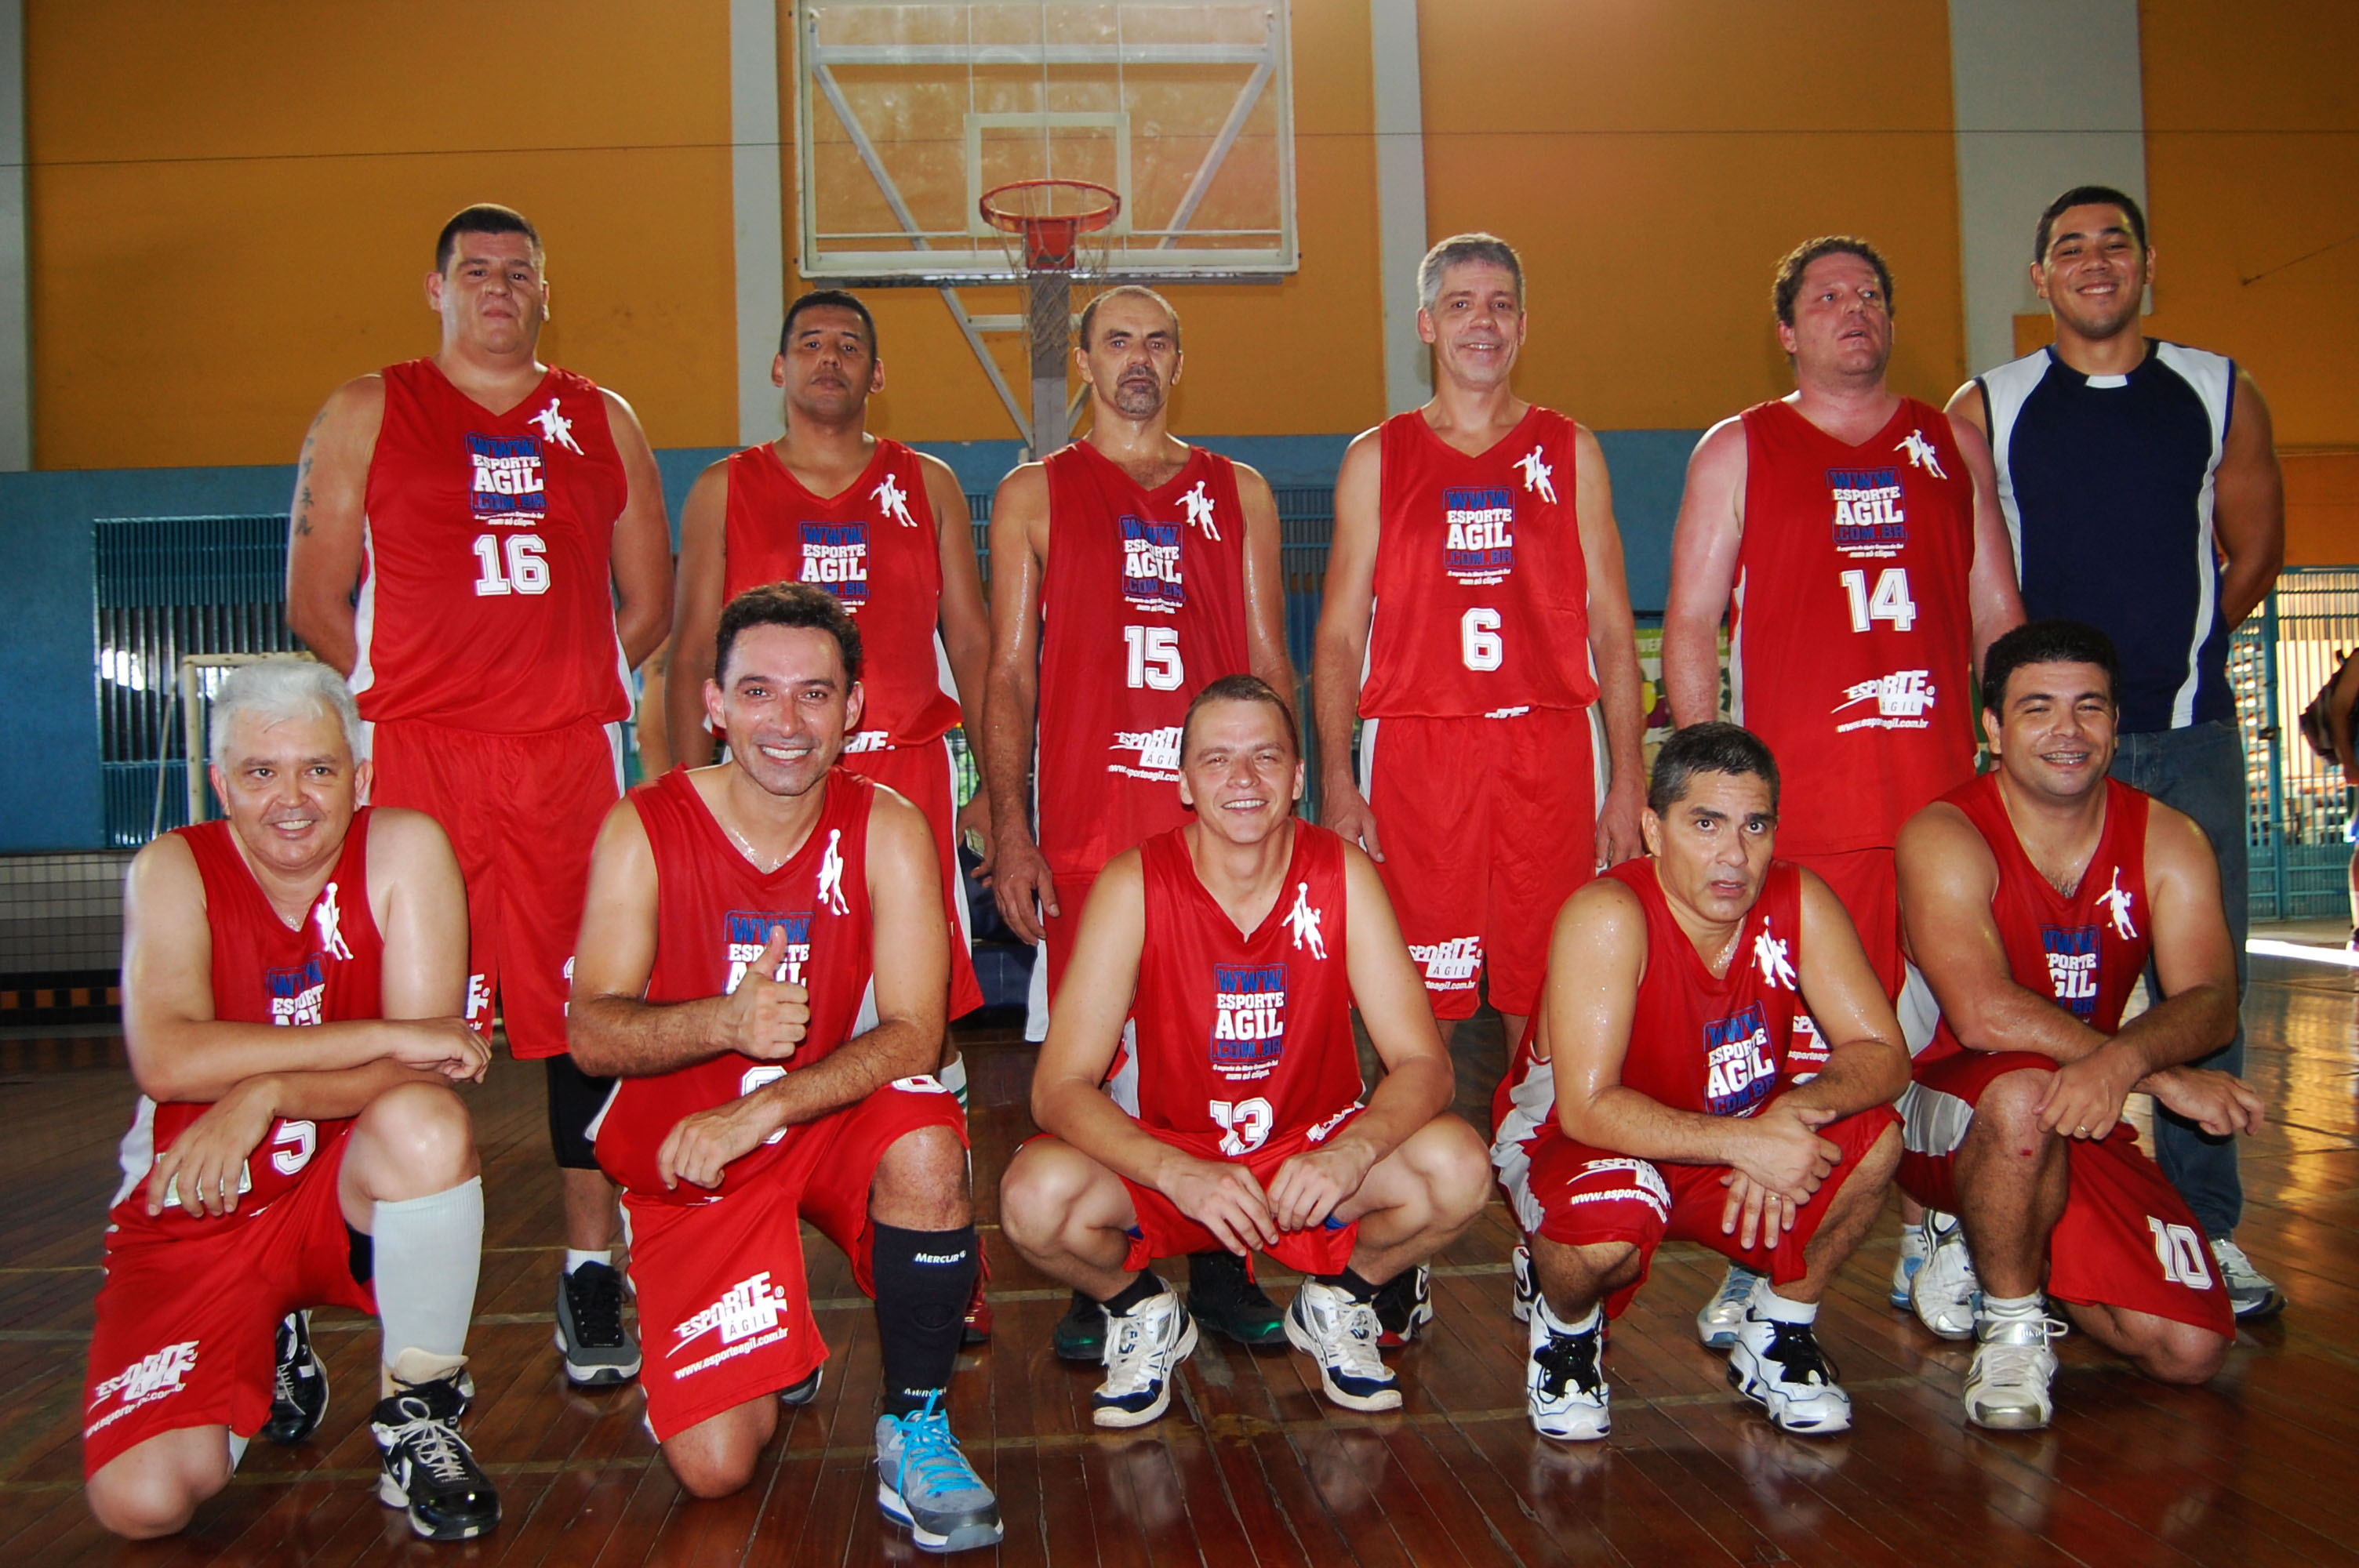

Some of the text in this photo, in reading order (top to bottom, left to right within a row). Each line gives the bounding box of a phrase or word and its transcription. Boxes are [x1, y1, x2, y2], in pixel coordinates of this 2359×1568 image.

[473, 453, 541, 470] ESPORTE
[474, 466, 544, 495] AGIL
[1833, 486, 1901, 502] ESPORTE
[1448, 508, 1512, 524] ESPORTE
[1835, 499, 1904, 525] AGIL
[803, 543, 866, 558] ESPORTE
[1124, 539, 1180, 561] ESPORTE
[1447, 522, 1513, 550] AGIL
[474, 535, 551, 596] 16
[801, 557, 867, 582] AGIL
[1125, 551, 1183, 584] AGIL
[1840, 568, 1916, 633] 14
[1463, 608, 1503, 671] 6
[1125, 626, 1183, 691] 15
[1217, 992, 1285, 1010] ESPORTE
[1215, 1008, 1284, 1040] AGIL
[1708, 1047, 1776, 1098] AGIL
[1210, 1097, 1274, 1157] 13
[2147, 1215, 2212, 1290] 10
[680, 1271, 772, 1338] ESPORTE
